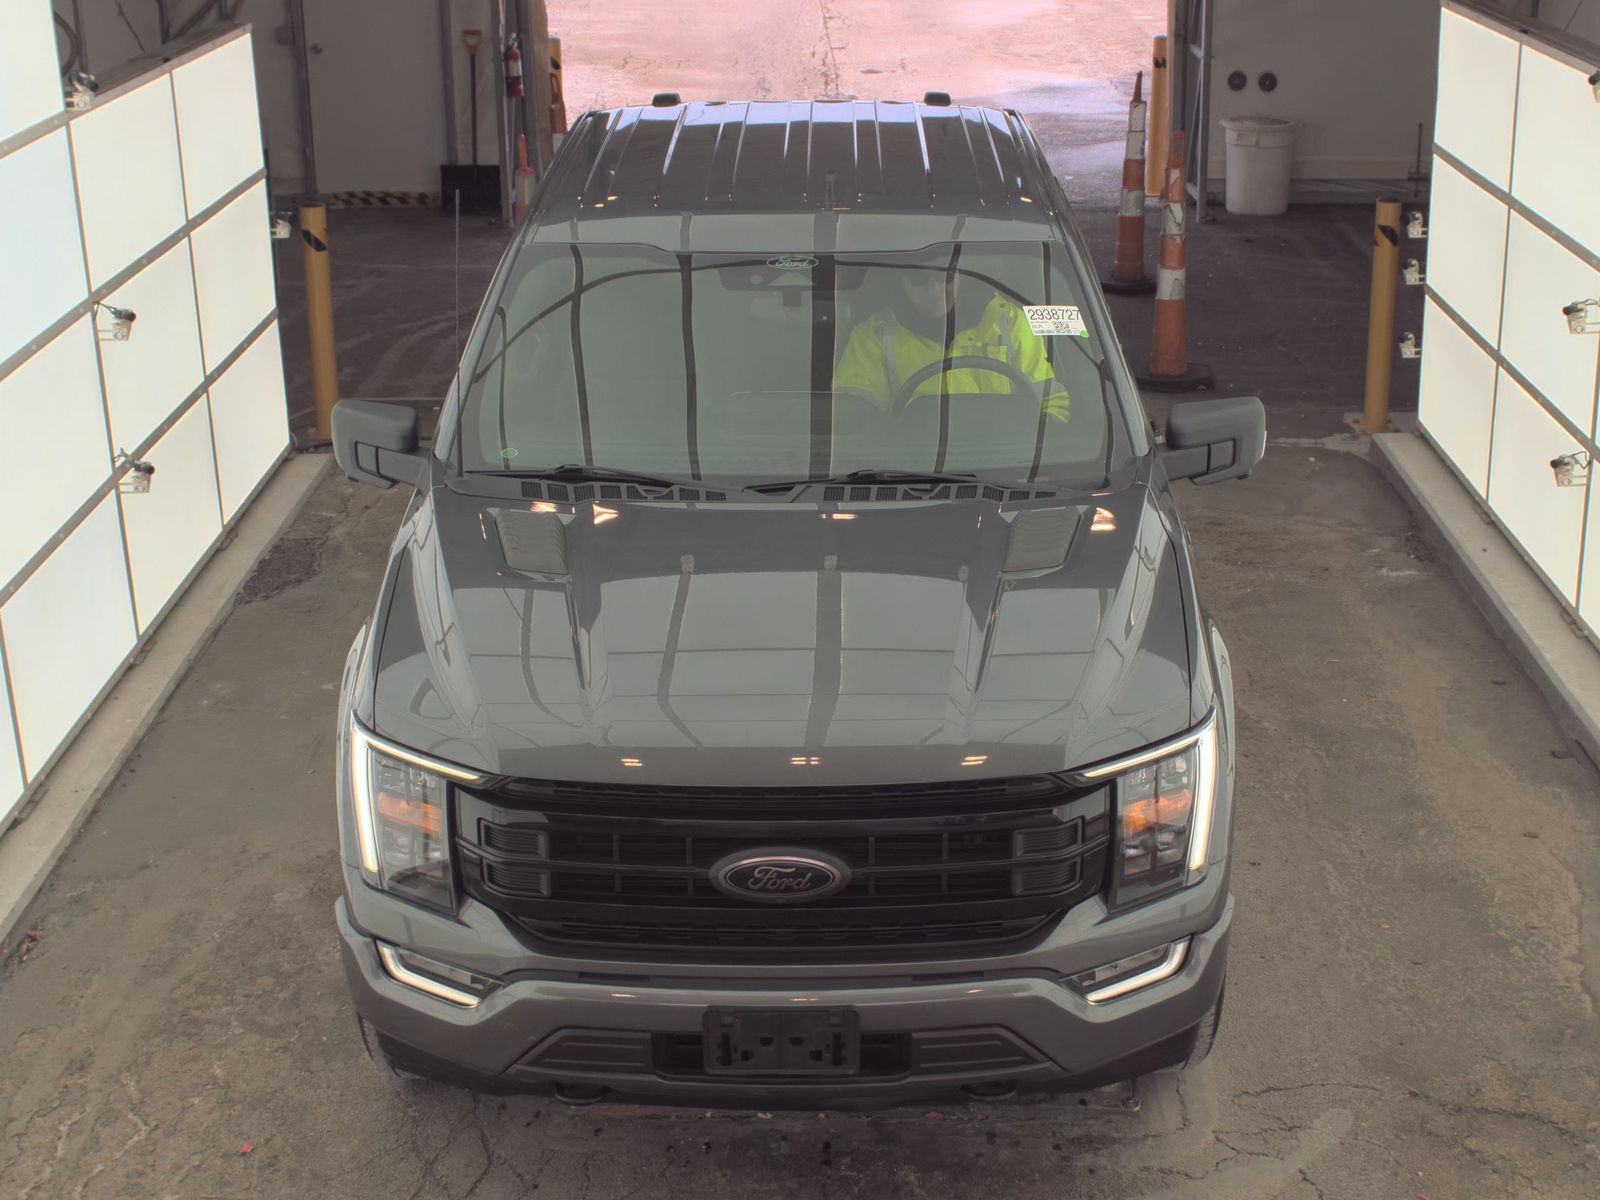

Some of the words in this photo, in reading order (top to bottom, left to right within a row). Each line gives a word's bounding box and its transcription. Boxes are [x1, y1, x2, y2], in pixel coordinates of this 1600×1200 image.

[775, 256, 810, 267] Ford
[1027, 308, 1080, 321] 2938727
[747, 866, 812, 890] Ford
